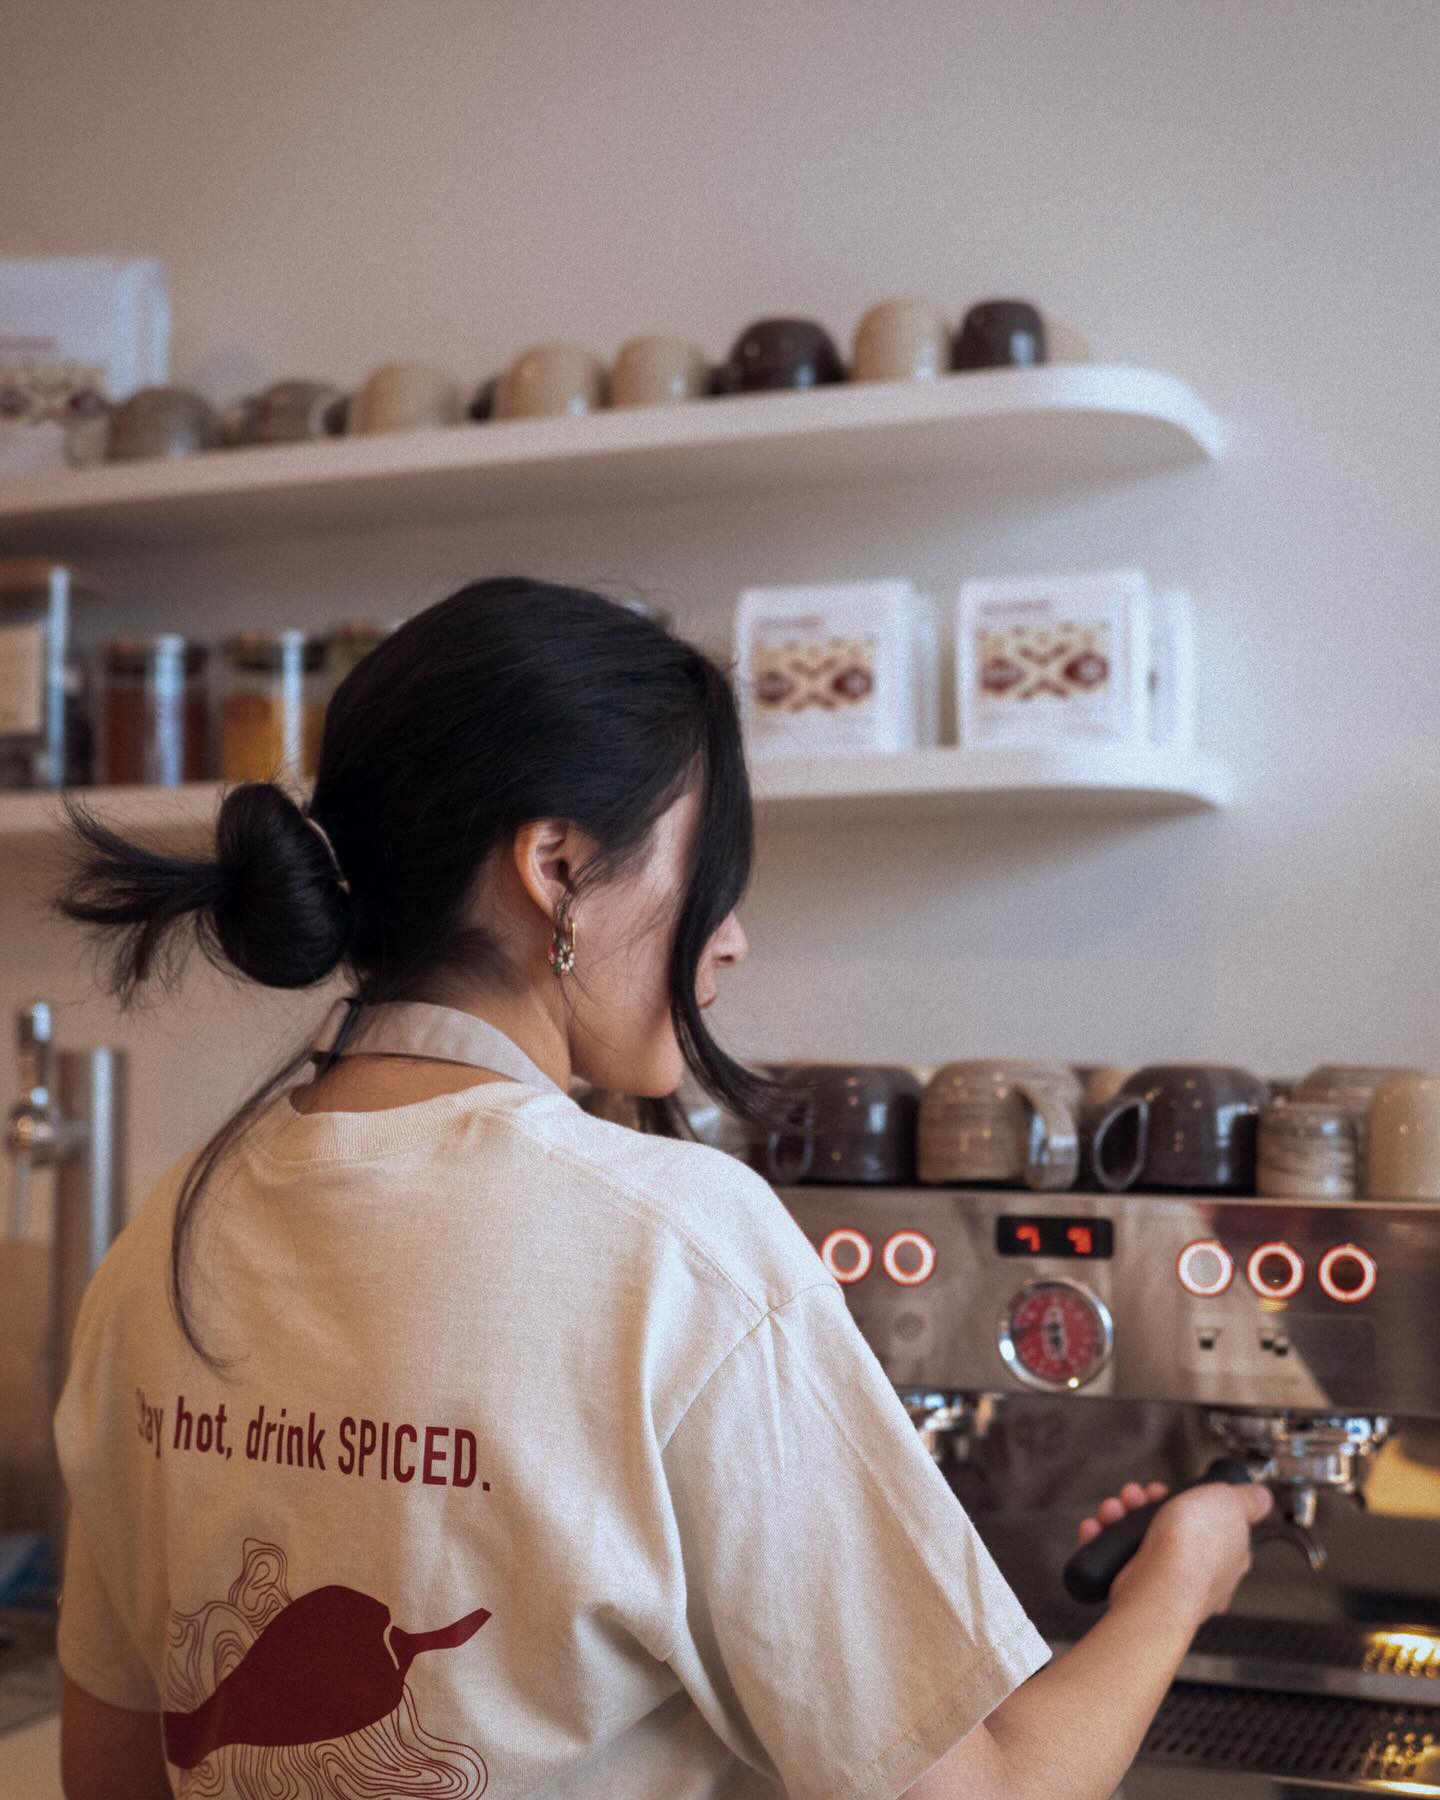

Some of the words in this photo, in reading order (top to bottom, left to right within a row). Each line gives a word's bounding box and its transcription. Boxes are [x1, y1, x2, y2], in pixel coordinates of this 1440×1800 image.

[173, 1395, 232, 1460] hot,
[246, 1405, 326, 1471] drink
[338, 1416, 491, 1491] SPICED.
